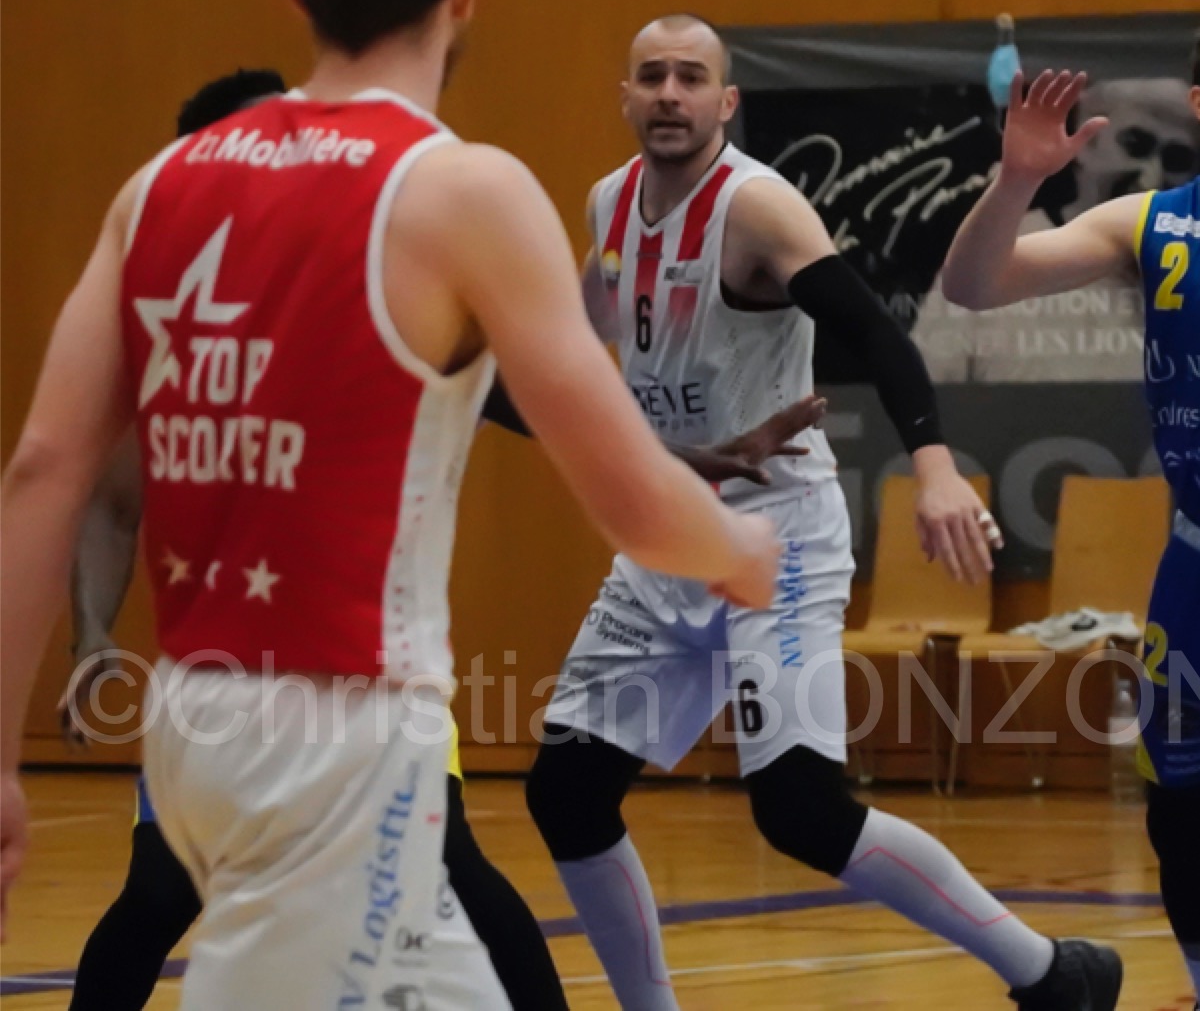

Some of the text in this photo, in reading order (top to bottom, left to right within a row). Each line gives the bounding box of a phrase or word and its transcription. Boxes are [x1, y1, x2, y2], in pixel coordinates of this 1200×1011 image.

[1153, 241, 1189, 311] 2
[635, 294, 653, 354] 6
[187, 336, 274, 406] TOP
[738, 678, 763, 738] 6
